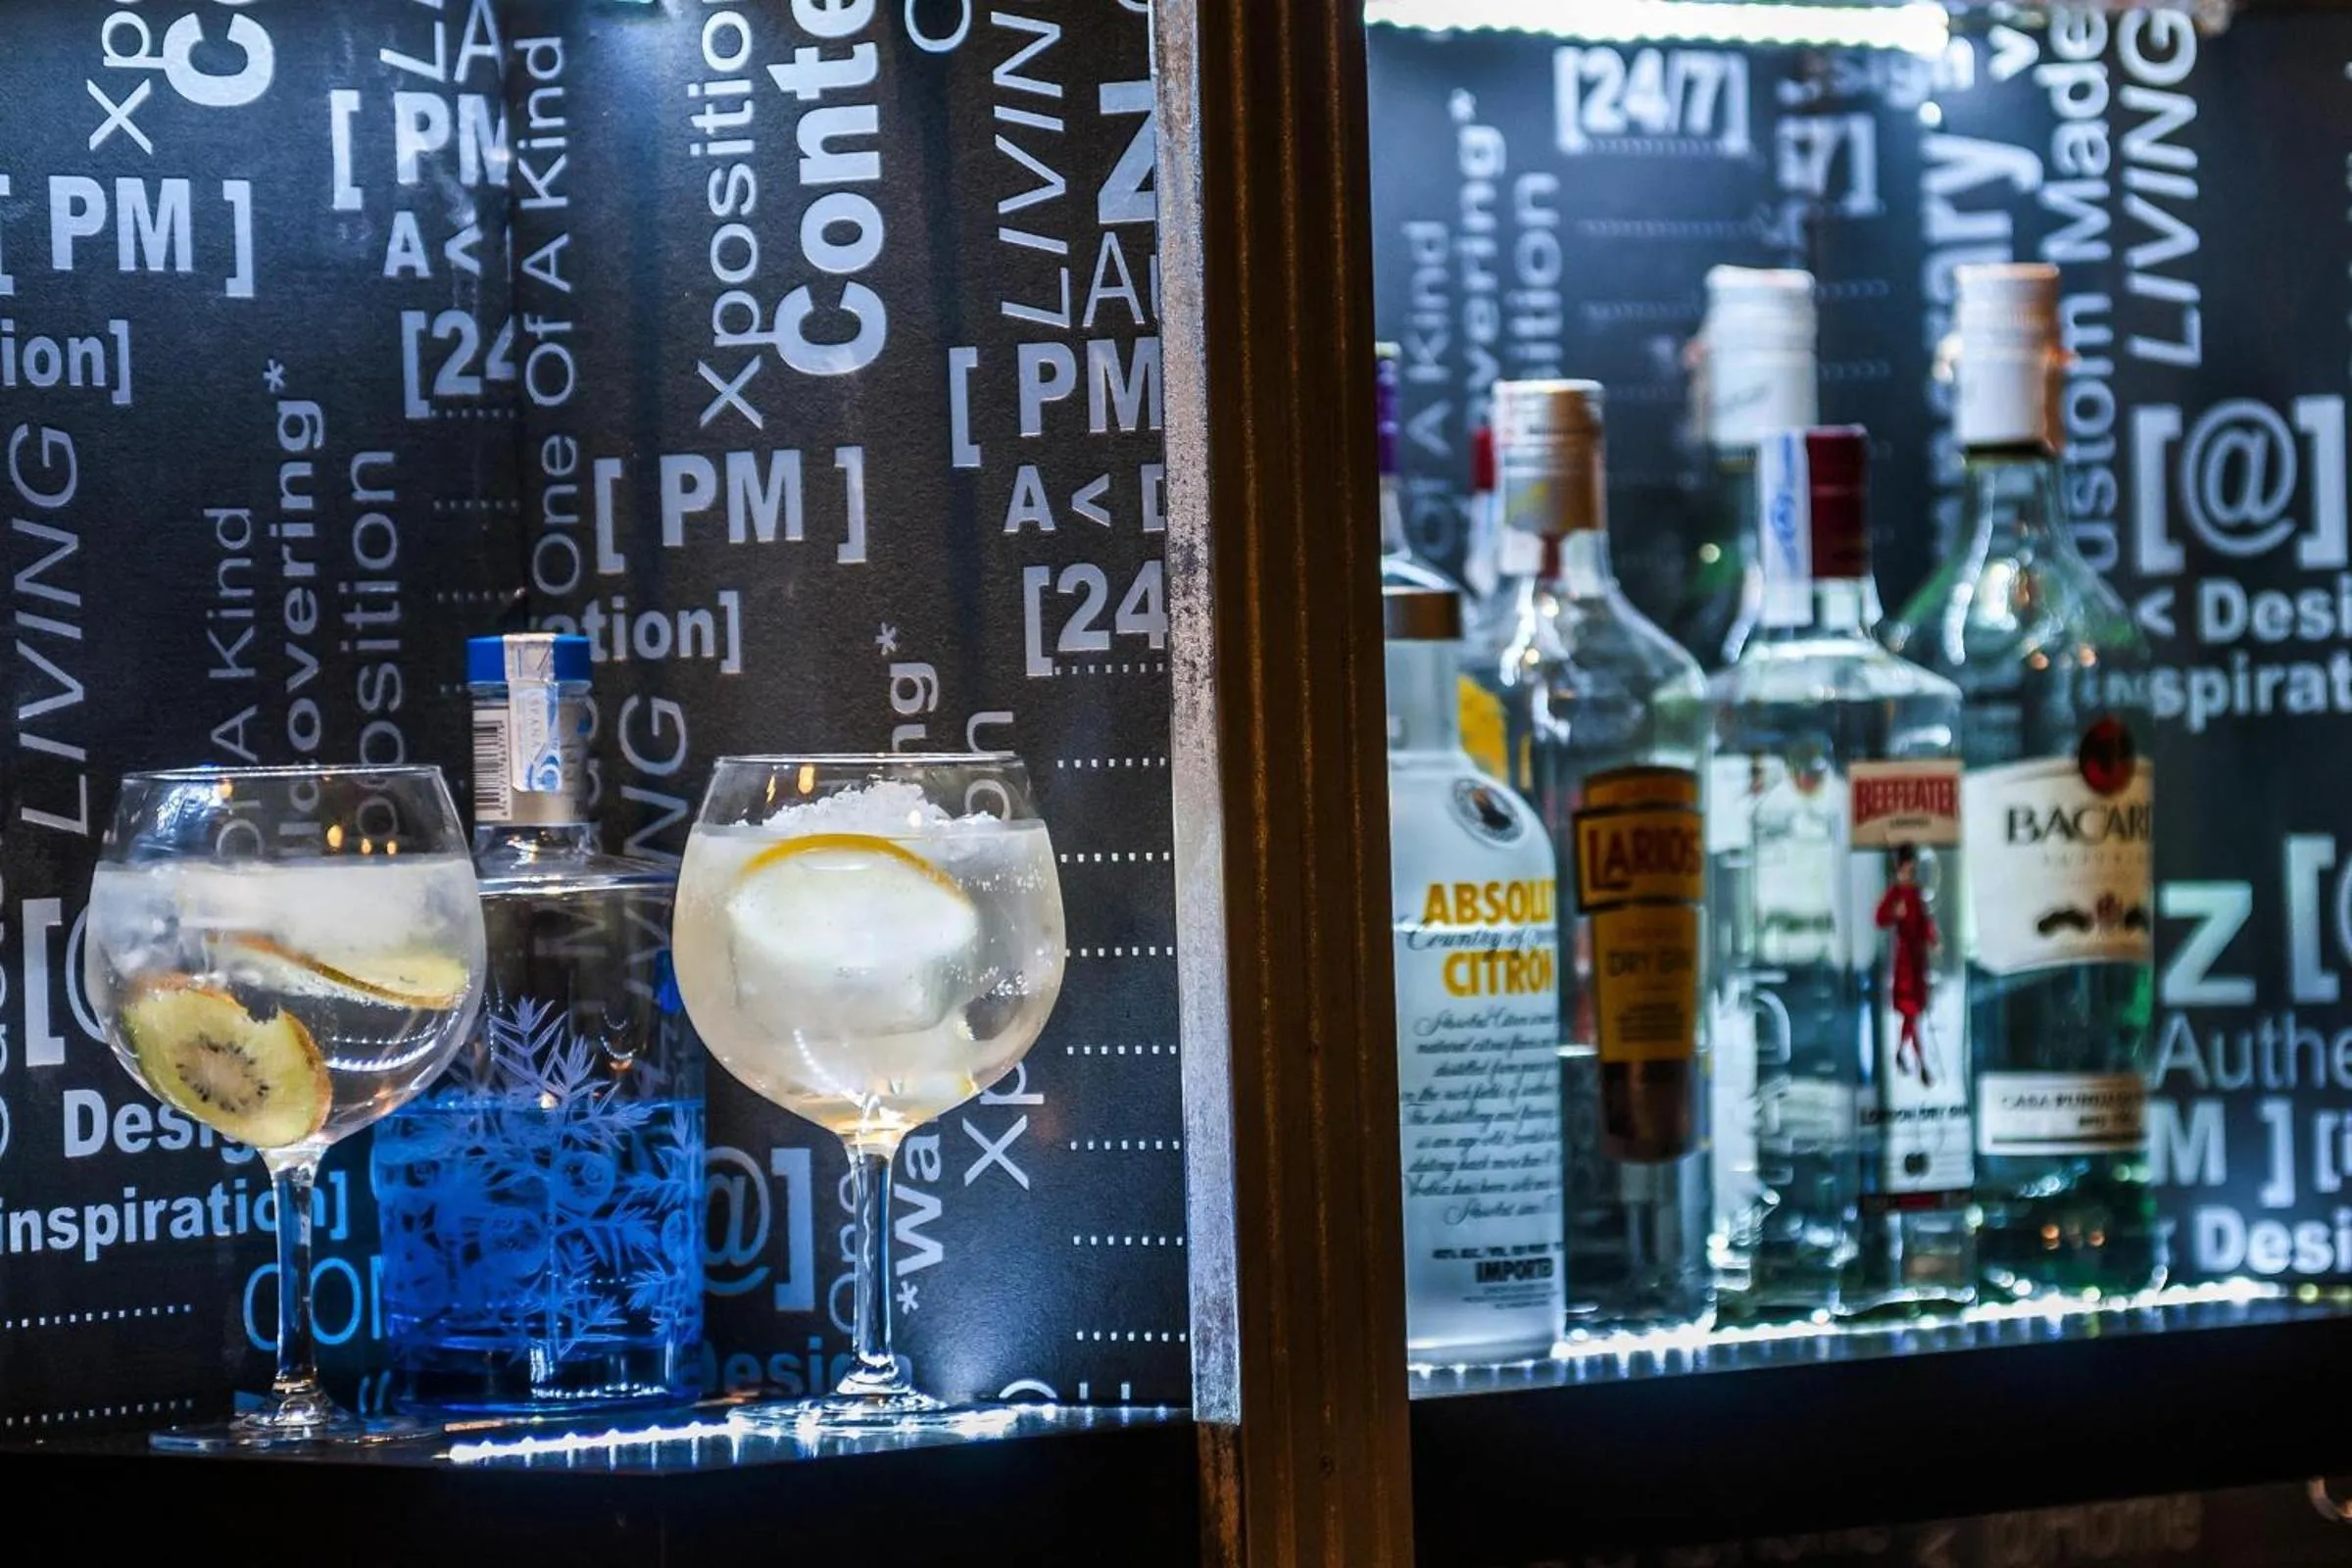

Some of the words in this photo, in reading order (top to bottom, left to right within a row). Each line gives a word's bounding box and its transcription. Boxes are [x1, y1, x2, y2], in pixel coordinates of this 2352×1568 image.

[514, 36, 567, 210] Kind
[2119, 8, 2202, 368] LIVING
[49, 175, 193, 272] PM
[520, 233, 570, 293] A
[687, 0, 764, 429] Xpositio
[525, 318, 576, 408] Of
[531, 433, 580, 596] One
[661, 450, 804, 547] PM
[8, 423, 88, 836] LIVING
[203, 508, 255, 678] Kind
[2159, 880, 2255, 1006] Z
